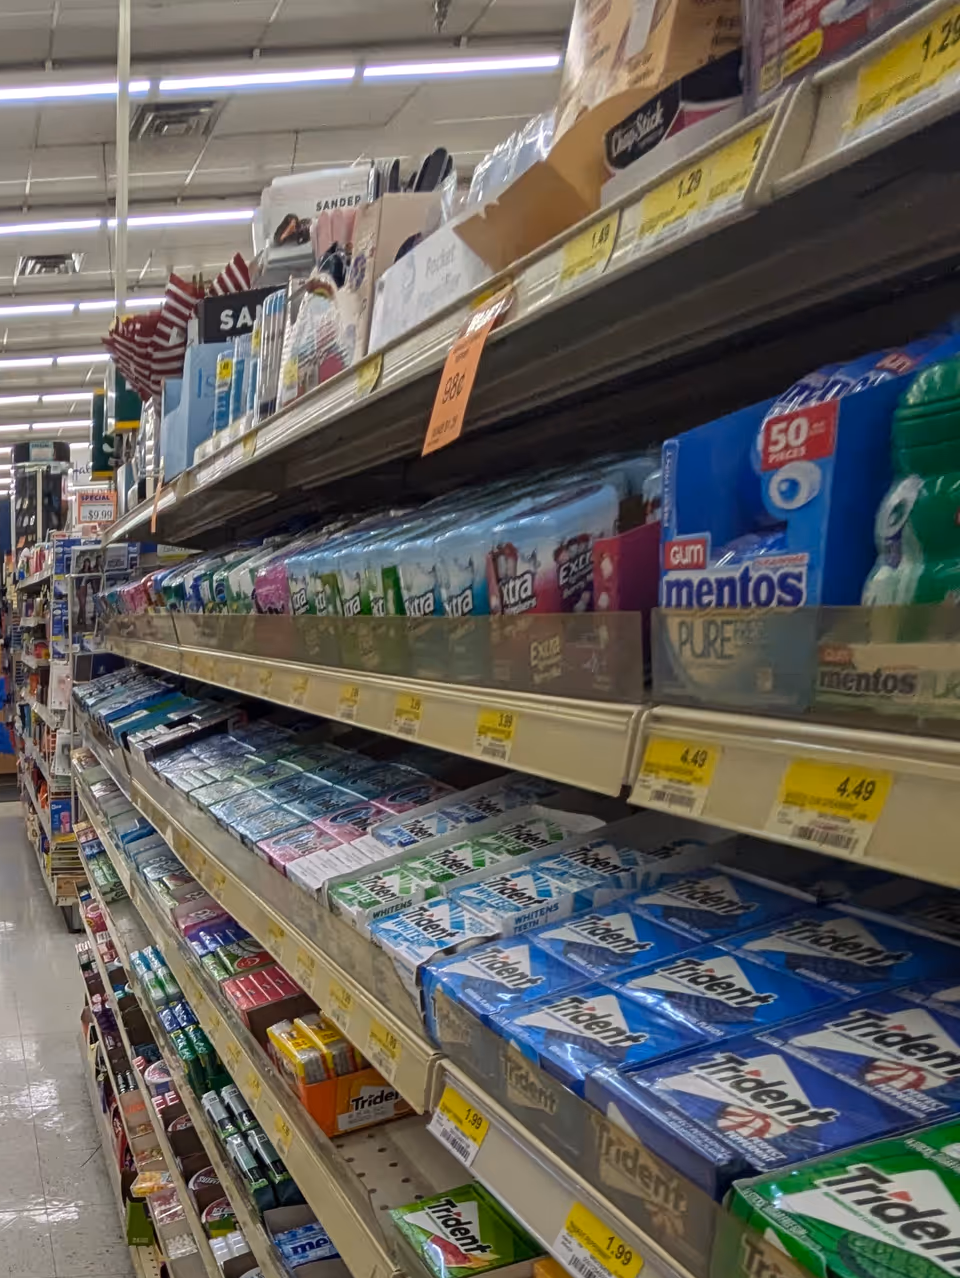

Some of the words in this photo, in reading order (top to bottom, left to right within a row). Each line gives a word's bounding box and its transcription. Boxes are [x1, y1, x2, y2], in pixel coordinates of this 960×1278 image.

[677, 169, 703, 199] 1.29
[592, 224, 611, 249] 1.49
[768, 417, 811, 452] 50
[768, 448, 806, 465] PIECES
[88, 509, 113, 520] $9.99
[500, 572, 533, 601] xtra
[664, 567, 805, 611] mentos
[444, 588, 474, 617] xtra
[820, 668, 918, 695] mentos
[680, 748, 708, 769] 4.49
[837, 777, 877, 802] 4.49
[482, 876, 549, 909] Trident
[666, 878, 757, 915] Trident
[401, 907, 460, 941] Trident
[514, 919, 540, 933] TEETH
[515, 903, 559, 926] WHITENS
[570, 914, 653, 952] Trident
[786, 921, 910, 966] Trident
[470, 947, 545, 988] Trident
[659, 957, 777, 1007] Trident
[547, 996, 648, 1046] Trident
[693, 1053, 838, 1127] Trident
[464, 1108, 483, 1130] 1.99
[595, 1122, 689, 1212] Trident
[428, 1199, 492, 1254] Trident
[606, 1236, 634, 1266] 1.99
